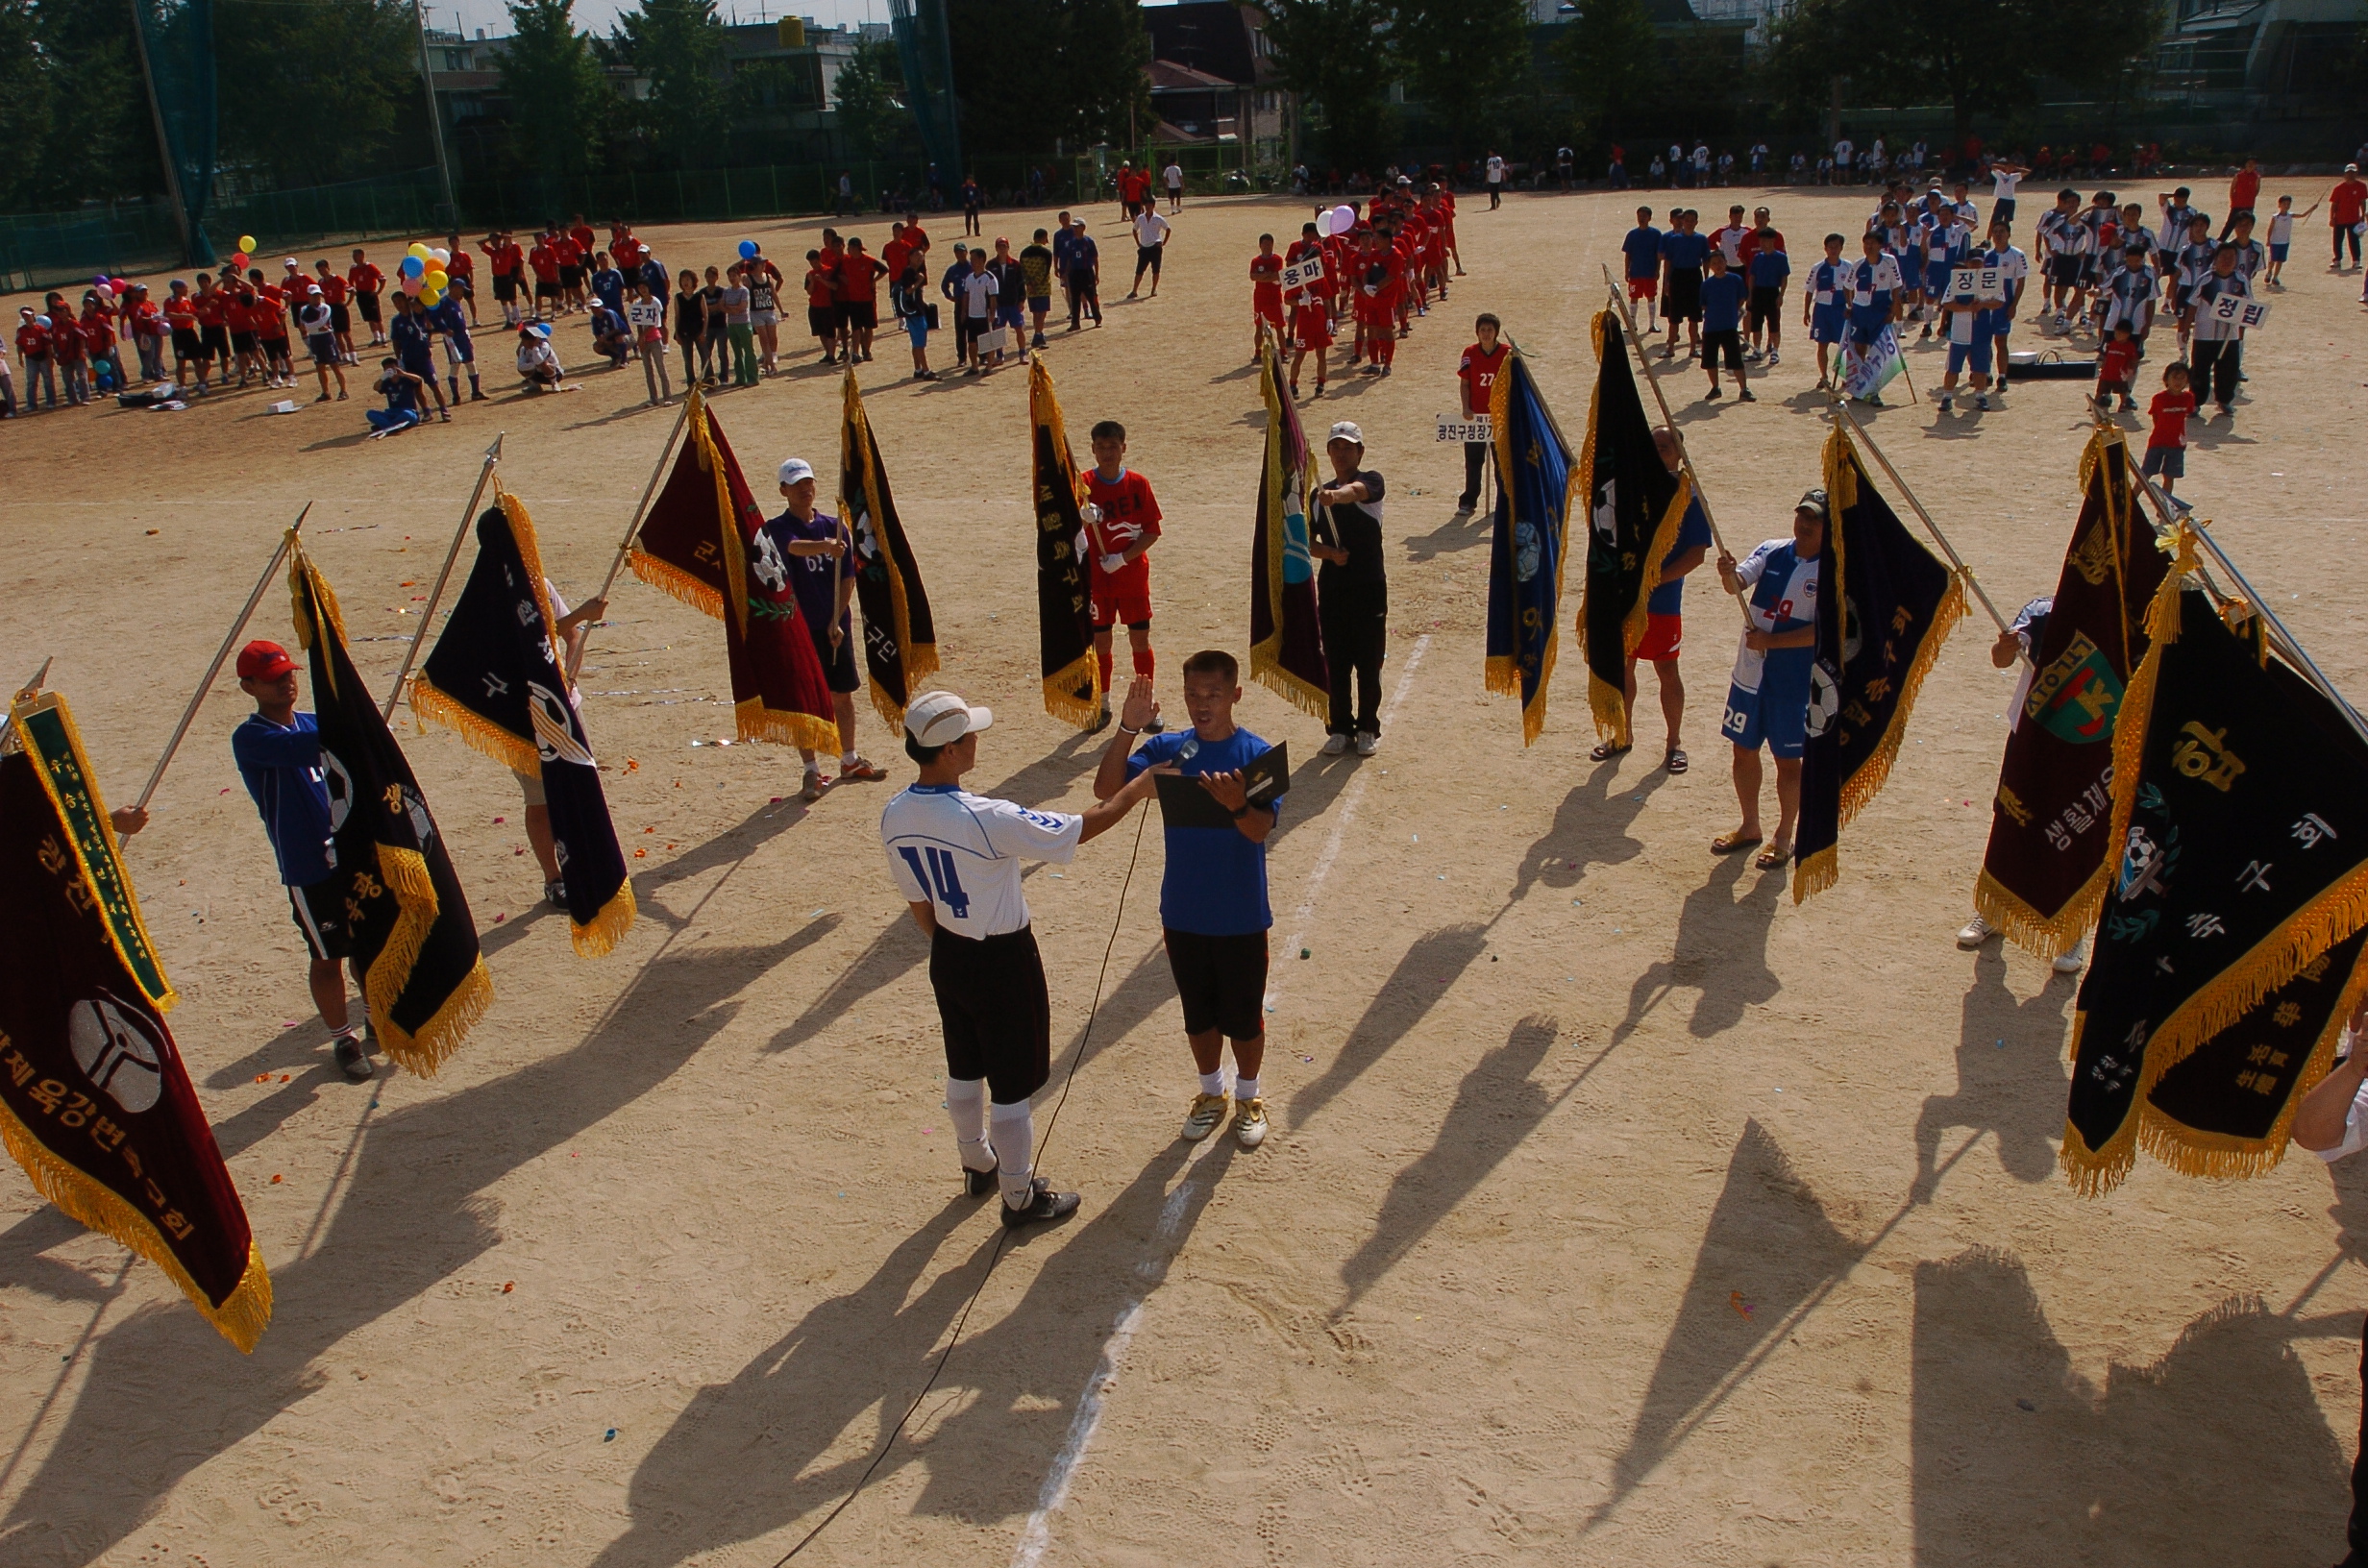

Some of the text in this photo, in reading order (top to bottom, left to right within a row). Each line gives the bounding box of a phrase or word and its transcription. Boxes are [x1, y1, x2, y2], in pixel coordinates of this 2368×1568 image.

[1284, 260, 1320, 285] 용마
[1958, 271, 1997, 290] 장문
[630, 308, 657, 323] 군자
[2217, 297, 2264, 326] 정립
[1480, 372, 1495, 386] 27
[1763, 595, 1794, 624] 29
[1723, 705, 1747, 734] 29
[897, 845, 971, 919] 14
